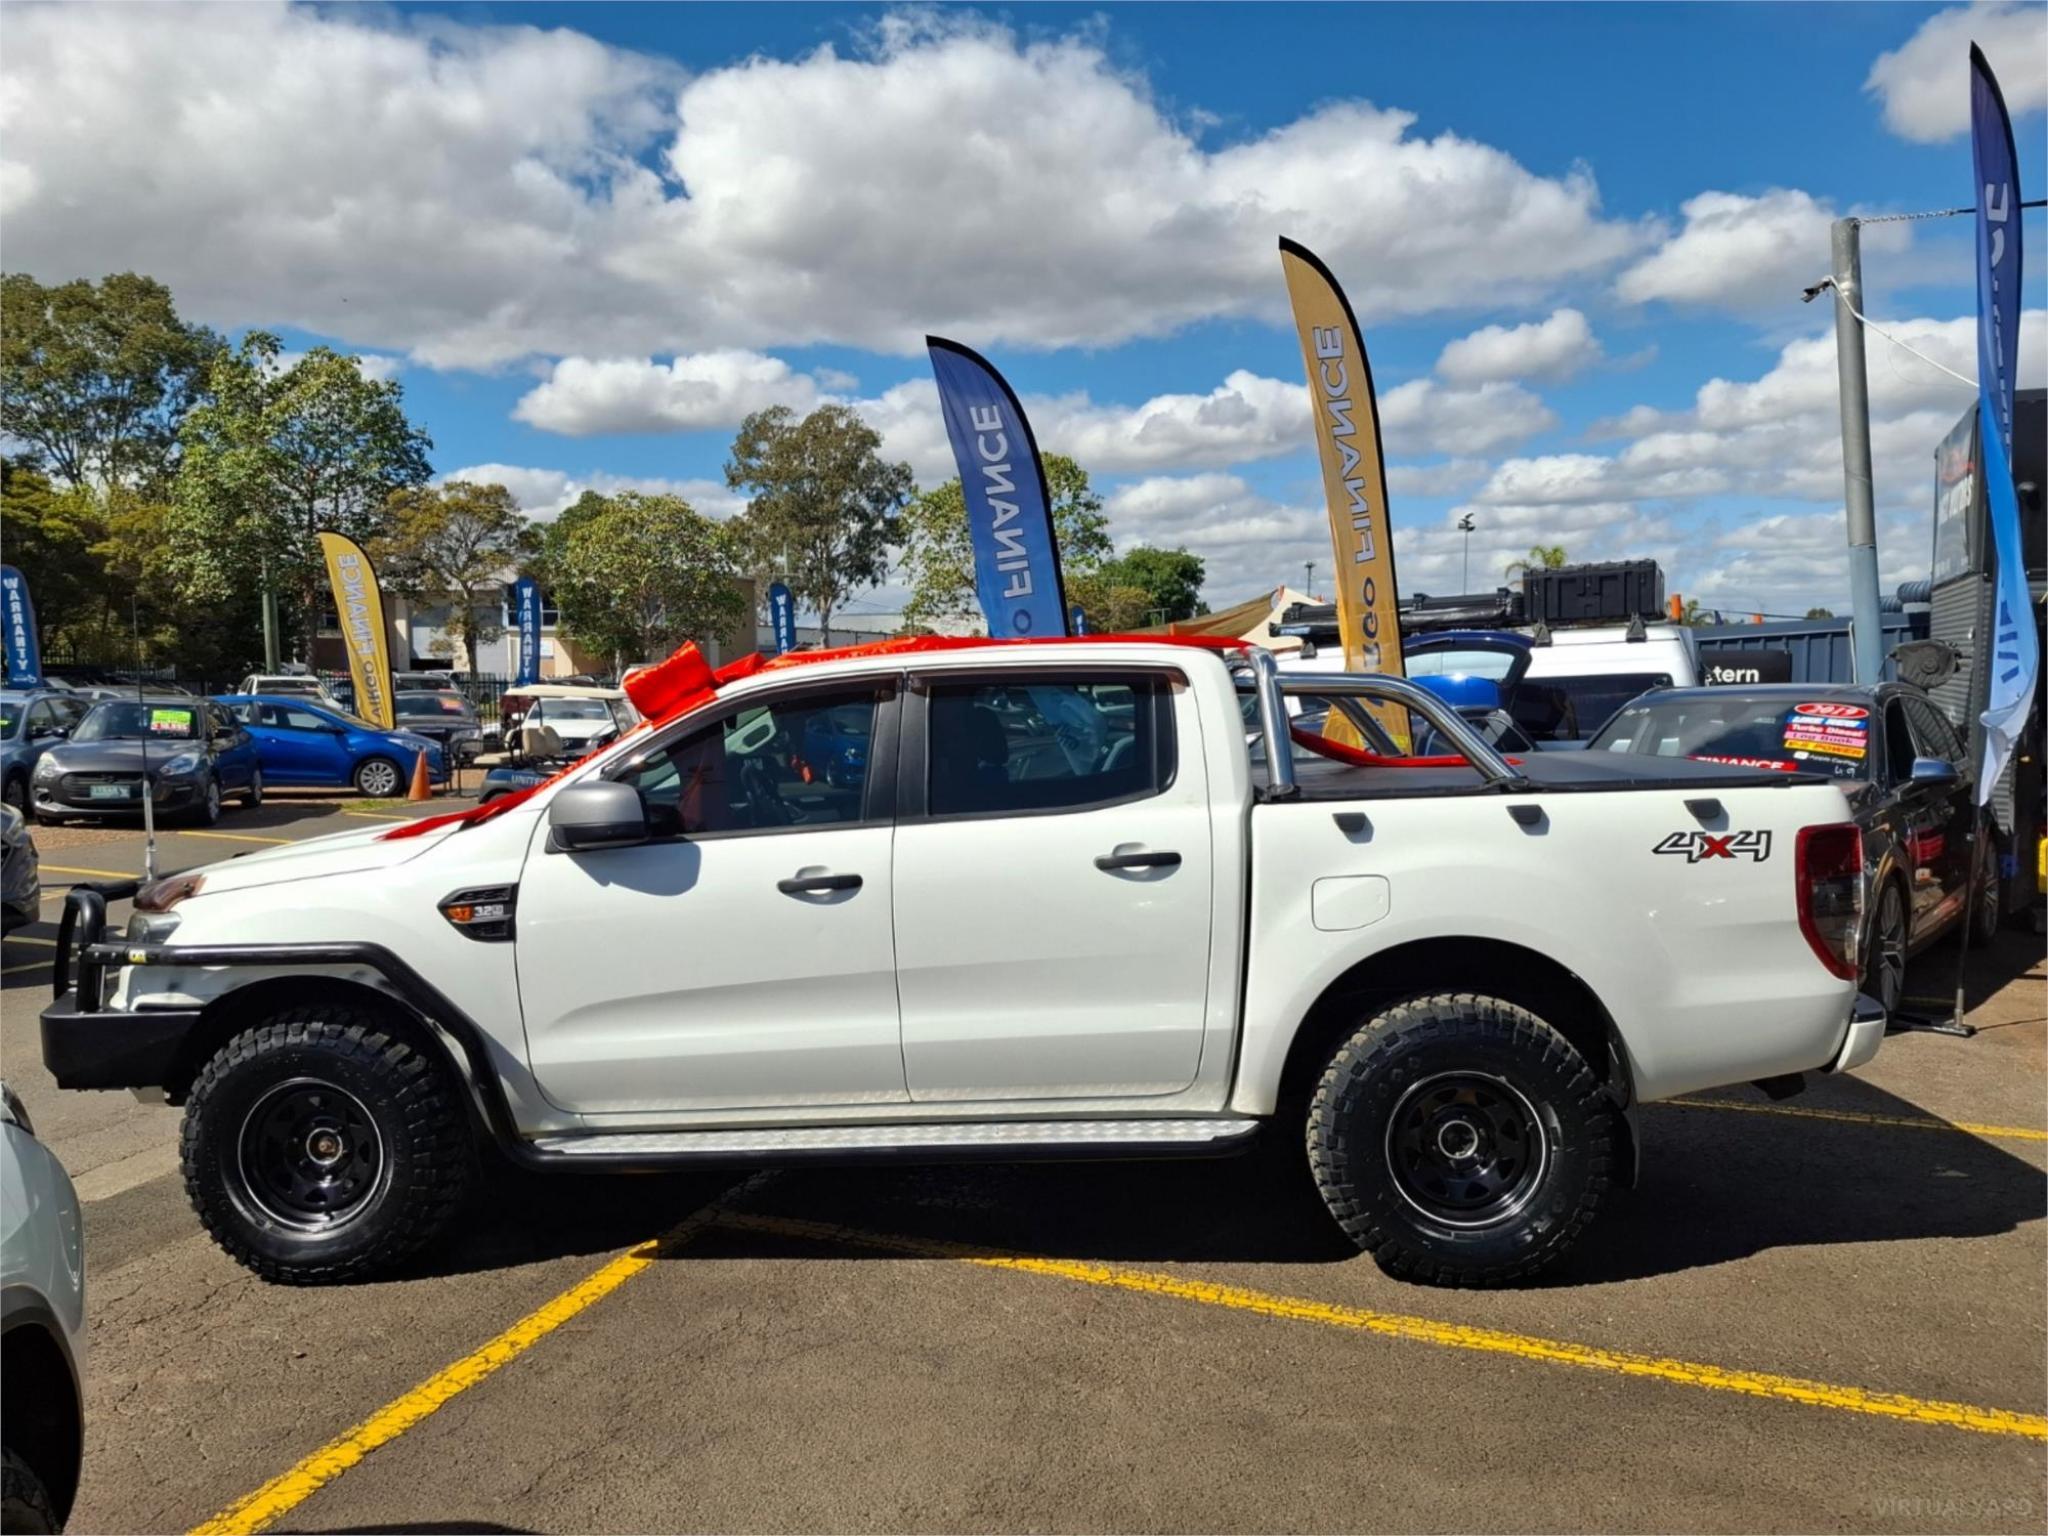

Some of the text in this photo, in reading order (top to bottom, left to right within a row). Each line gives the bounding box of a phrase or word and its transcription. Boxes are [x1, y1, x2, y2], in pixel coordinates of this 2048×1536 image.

[3, 577, 29, 671] WARRANTY
[521, 587, 533, 678] WARRANTY
[1711, 665, 1760, 684] tern
[1651, 830, 1773, 864] 4x4
